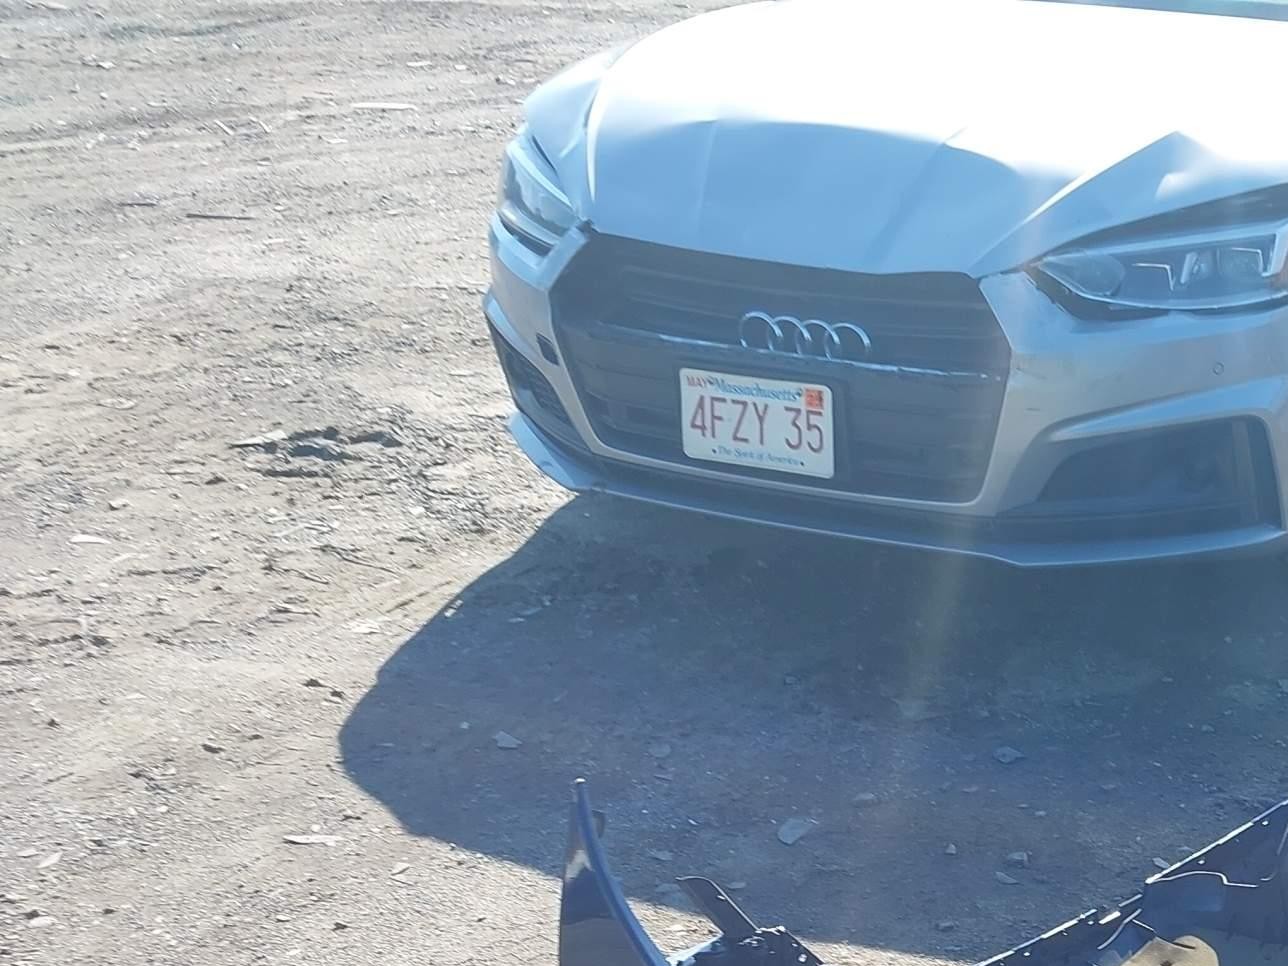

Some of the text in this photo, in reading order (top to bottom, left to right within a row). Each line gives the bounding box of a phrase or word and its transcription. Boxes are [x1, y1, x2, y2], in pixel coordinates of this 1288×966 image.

[713, 377, 798, 401] Massachusetts
[690, 395, 770, 446] 4FZY
[784, 406, 824, 454] 35
